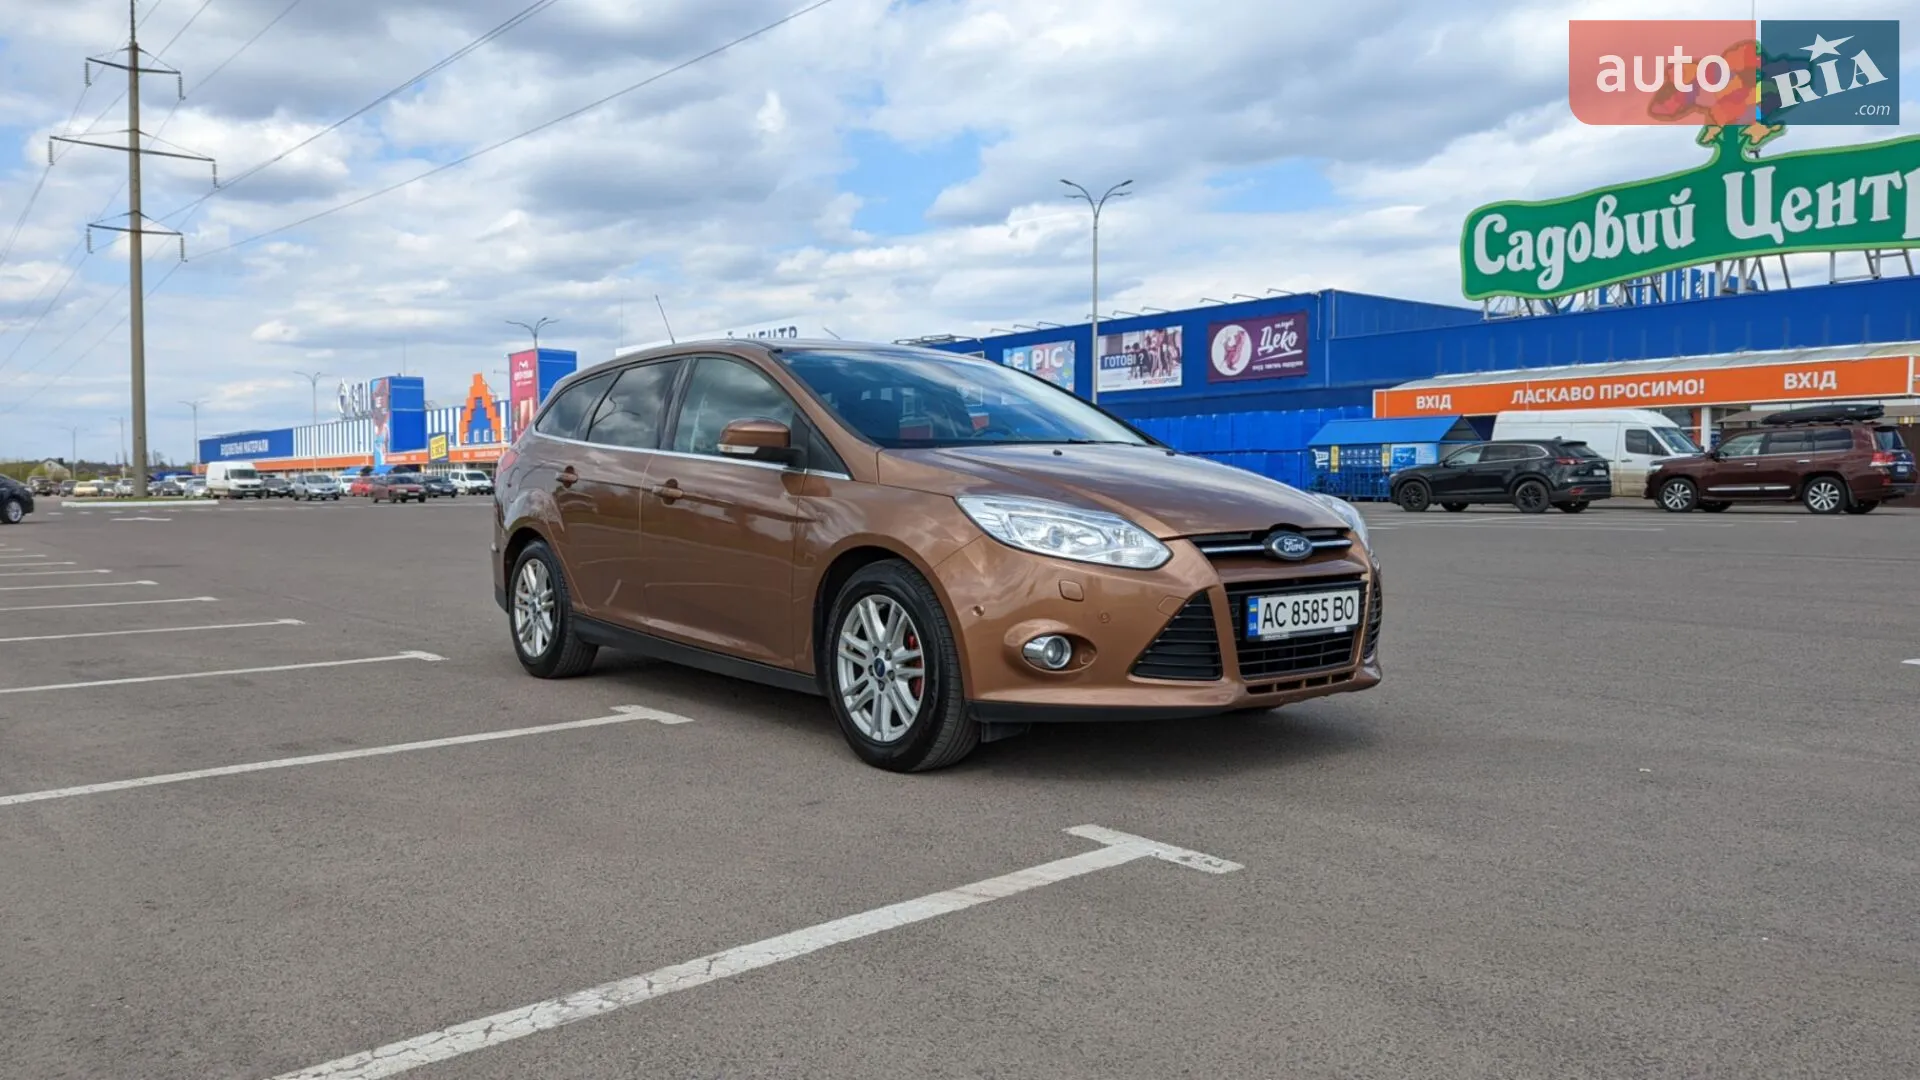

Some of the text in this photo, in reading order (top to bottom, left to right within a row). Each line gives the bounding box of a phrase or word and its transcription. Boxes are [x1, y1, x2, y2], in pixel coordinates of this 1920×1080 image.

[1473, 187, 1697, 291] Садовий
[1257, 326, 1298, 357] Деко
[1104, 354, 1137, 368] ГОТОВІ
[1510, 378, 1705, 405] ЛАСКАВО ПРОСИМО!
[1783, 370, 1838, 391] ВХІД
[1415, 394, 1453, 411] ВХІД
[1284, 538, 1305, 551] Ford
[1262, 595, 1355, 628] AC 8585 BO
